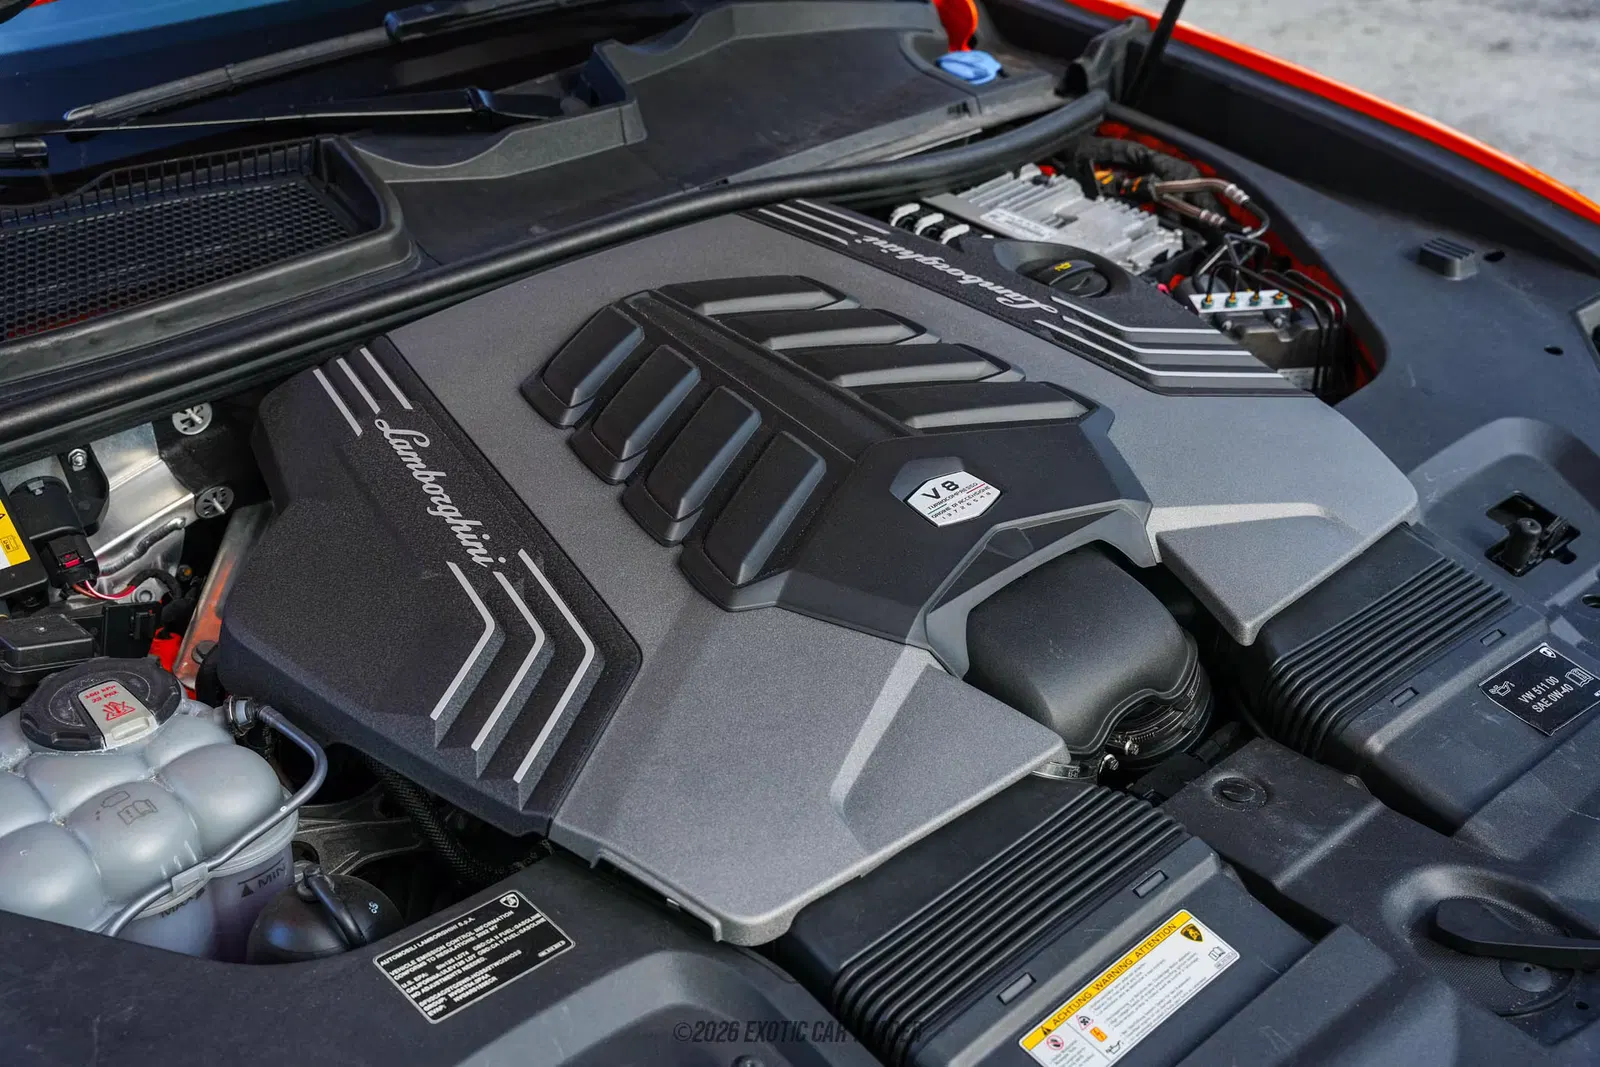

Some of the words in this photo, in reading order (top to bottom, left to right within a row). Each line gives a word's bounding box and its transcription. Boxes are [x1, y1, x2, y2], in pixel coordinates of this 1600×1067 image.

[854, 236, 1058, 314] Lamborghini
[374, 418, 507, 568] Lamborghini
[1518, 690, 1536, 704] VW
[1532, 682, 1550, 695] 511
[1546, 676, 1560, 686] 00
[1532, 698, 1553, 713] SAE
[1550, 683, 1574, 702] 0W-40
[258, 863, 288, 888] MIN
[378, 944, 417, 966] AUTOMOBILI
[416, 924, 458, 947] LAMBORGHINI
[388, 959, 417, 976] VEHICLE
[415, 944, 446, 962] EMISSION
[444, 930, 474, 947] CONTROL
[473, 910, 514, 932] INFORMATION
[392, 960, 428, 980] CONFORMS
[400, 979, 414, 988] U.S.
[419, 968, 462, 993] ADJUSTMENTS
[1052, 991, 1092, 1026] ACHTUNG
[1092, 958, 1133, 990] WARNING
[1135, 923, 1177, 958] ATTENTION
